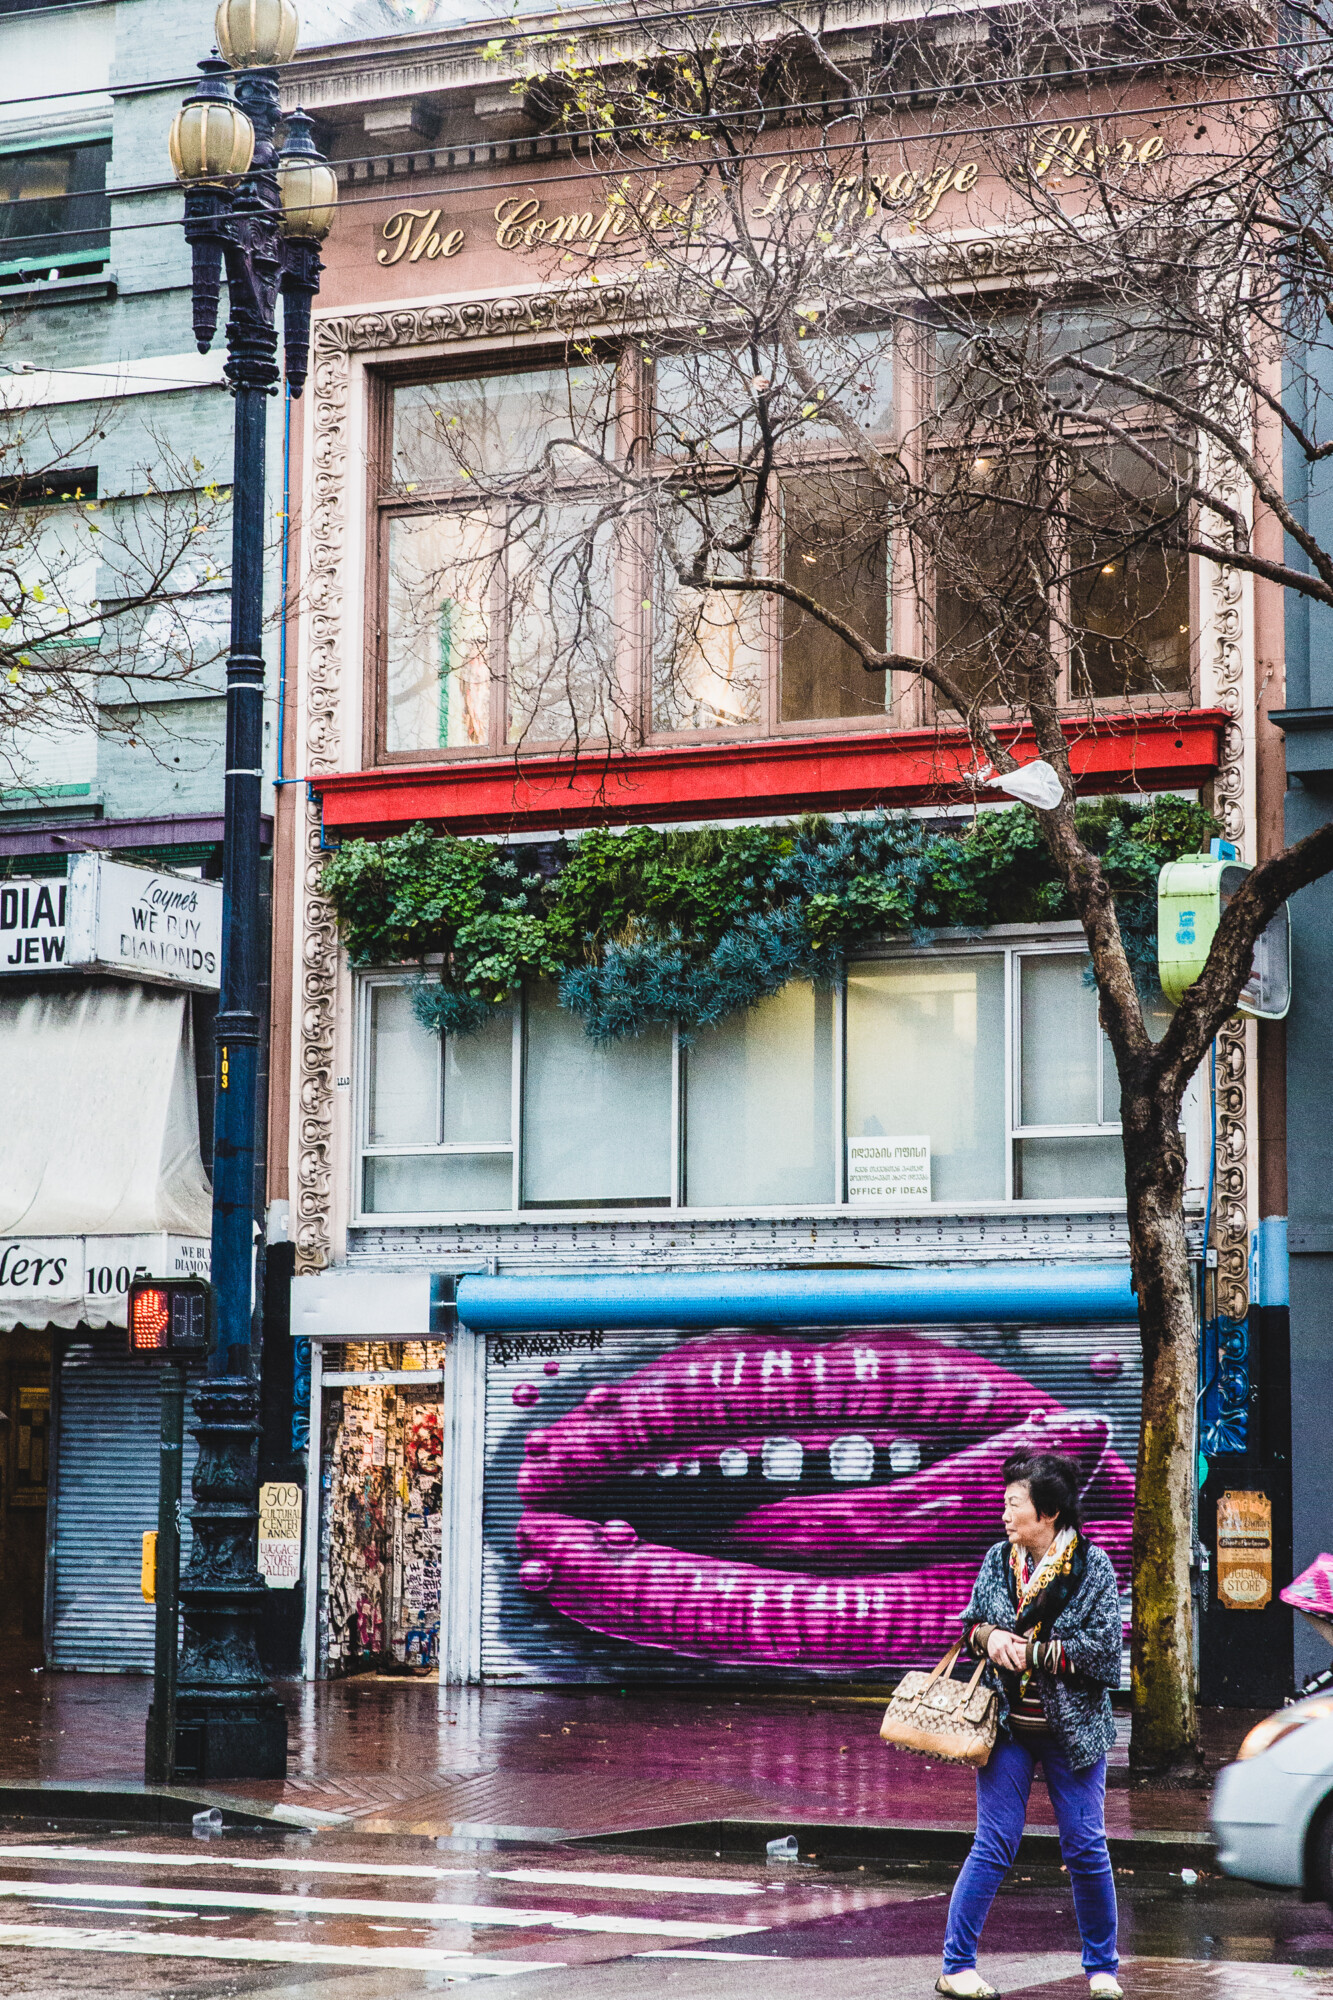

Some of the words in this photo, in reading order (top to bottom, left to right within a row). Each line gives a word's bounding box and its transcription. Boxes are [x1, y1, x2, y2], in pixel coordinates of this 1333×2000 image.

[377, 208, 464, 266] The
[140, 879, 198, 913] Layne's
[132, 906, 158, 933] WE
[166, 914, 201, 942] BUY
[7, 935, 66, 964] JEW
[120, 933, 216, 974] DIAMONDS
[850, 1187, 882, 1195] OFFICE
[900, 1186, 928, 1194] IDEAS
[181, 1246, 195, 1258] WE
[265, 1486, 299, 1507] 509
[260, 1508, 302, 1519] CULTURAL
[262, 1519, 298, 1530] CENTER
[267, 1529, 298, 1539] ANNEX
[263, 1554, 294, 1566] STORE
[258, 1565, 298, 1577] GALLERY
[1227, 1579, 1262, 1591] STORE
